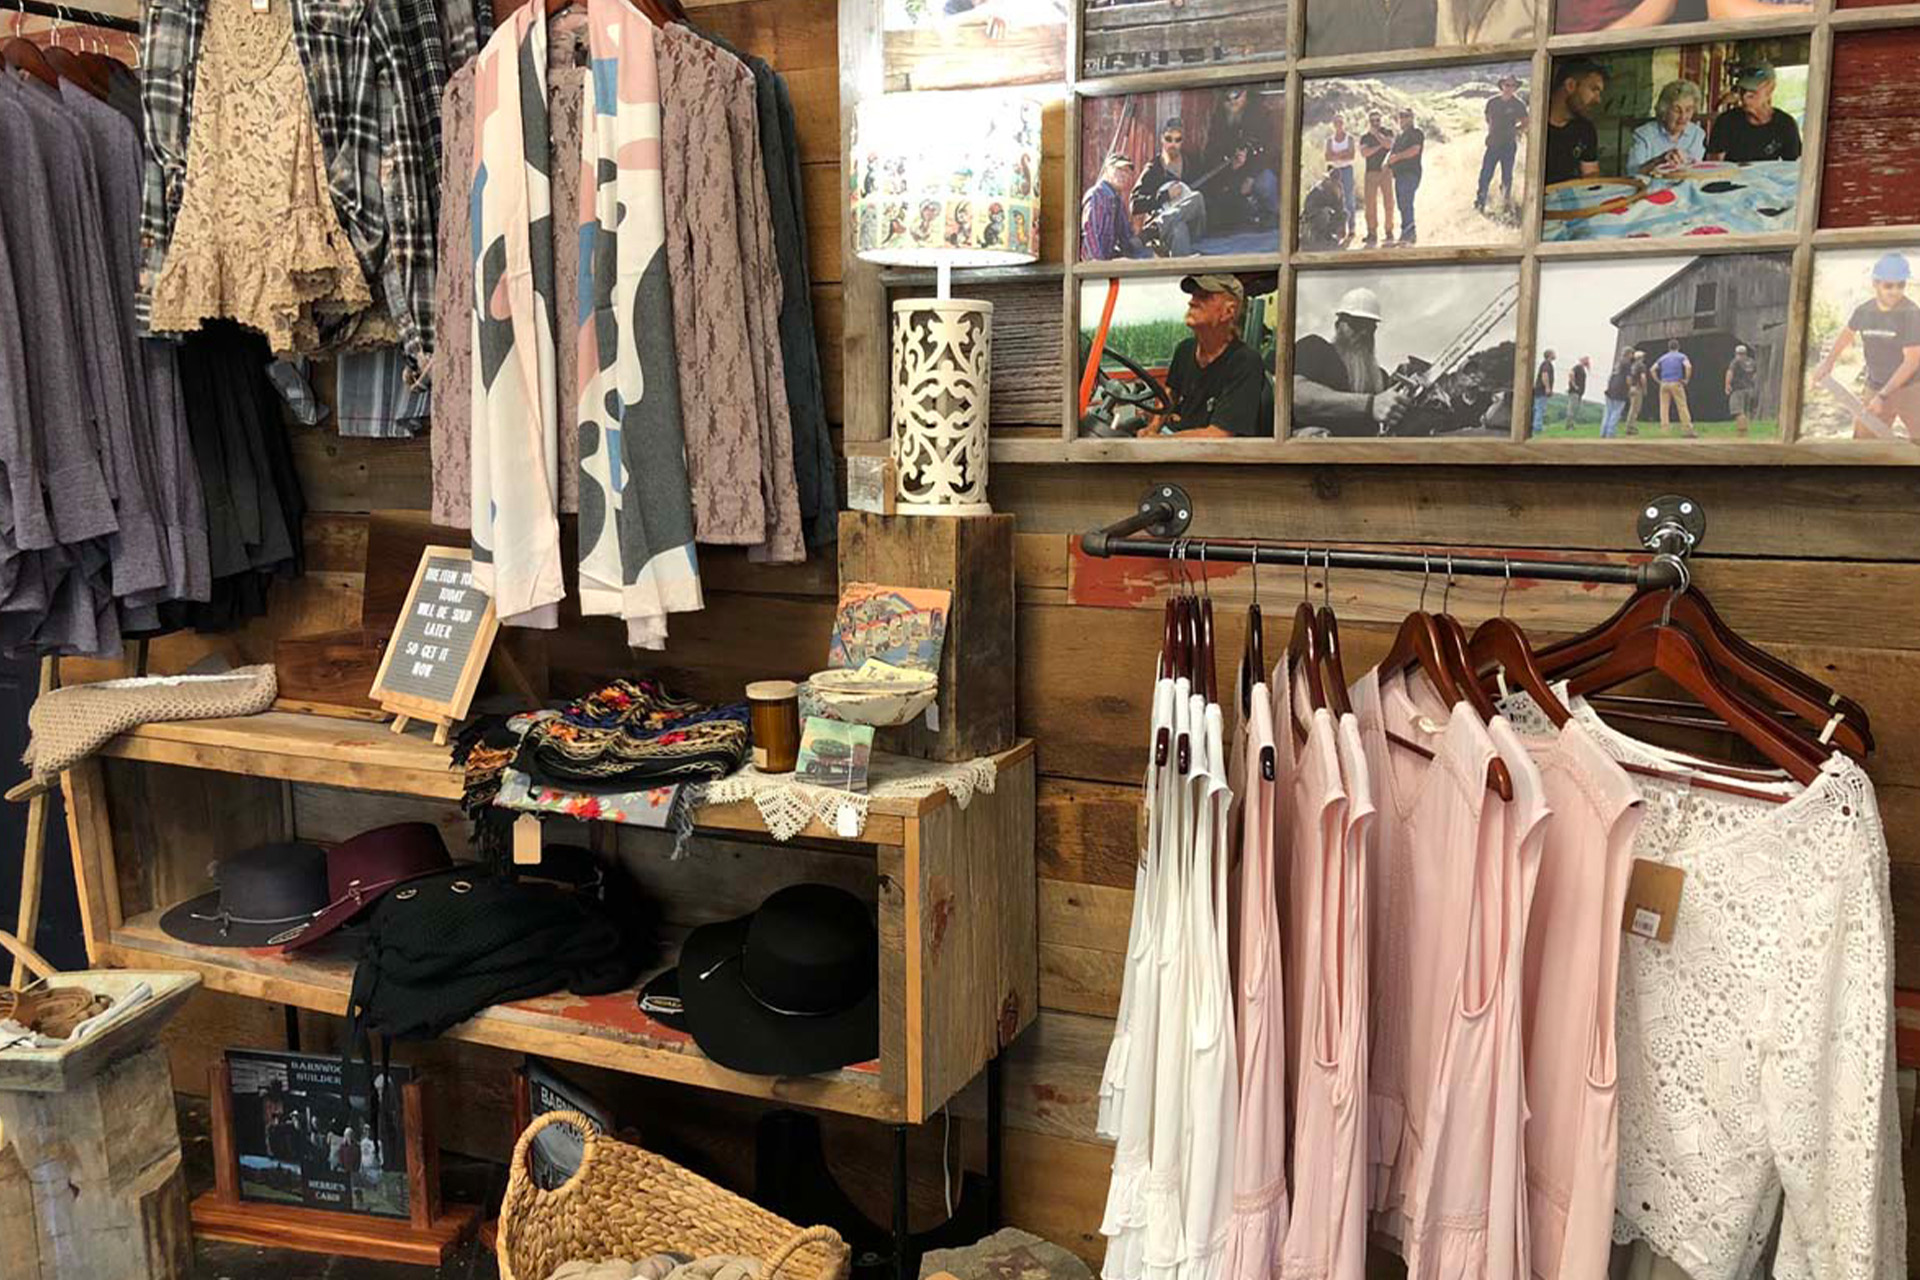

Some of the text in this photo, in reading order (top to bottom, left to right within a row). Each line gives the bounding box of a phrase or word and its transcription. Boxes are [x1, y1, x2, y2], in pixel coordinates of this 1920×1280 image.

[439, 587, 466, 603] TODAY
[417, 602, 472, 623] WILL BE SOLD
[424, 622, 453, 639] LATER
[405, 641, 449, 661] SO GET IT
[412, 661, 433, 678] NOW
